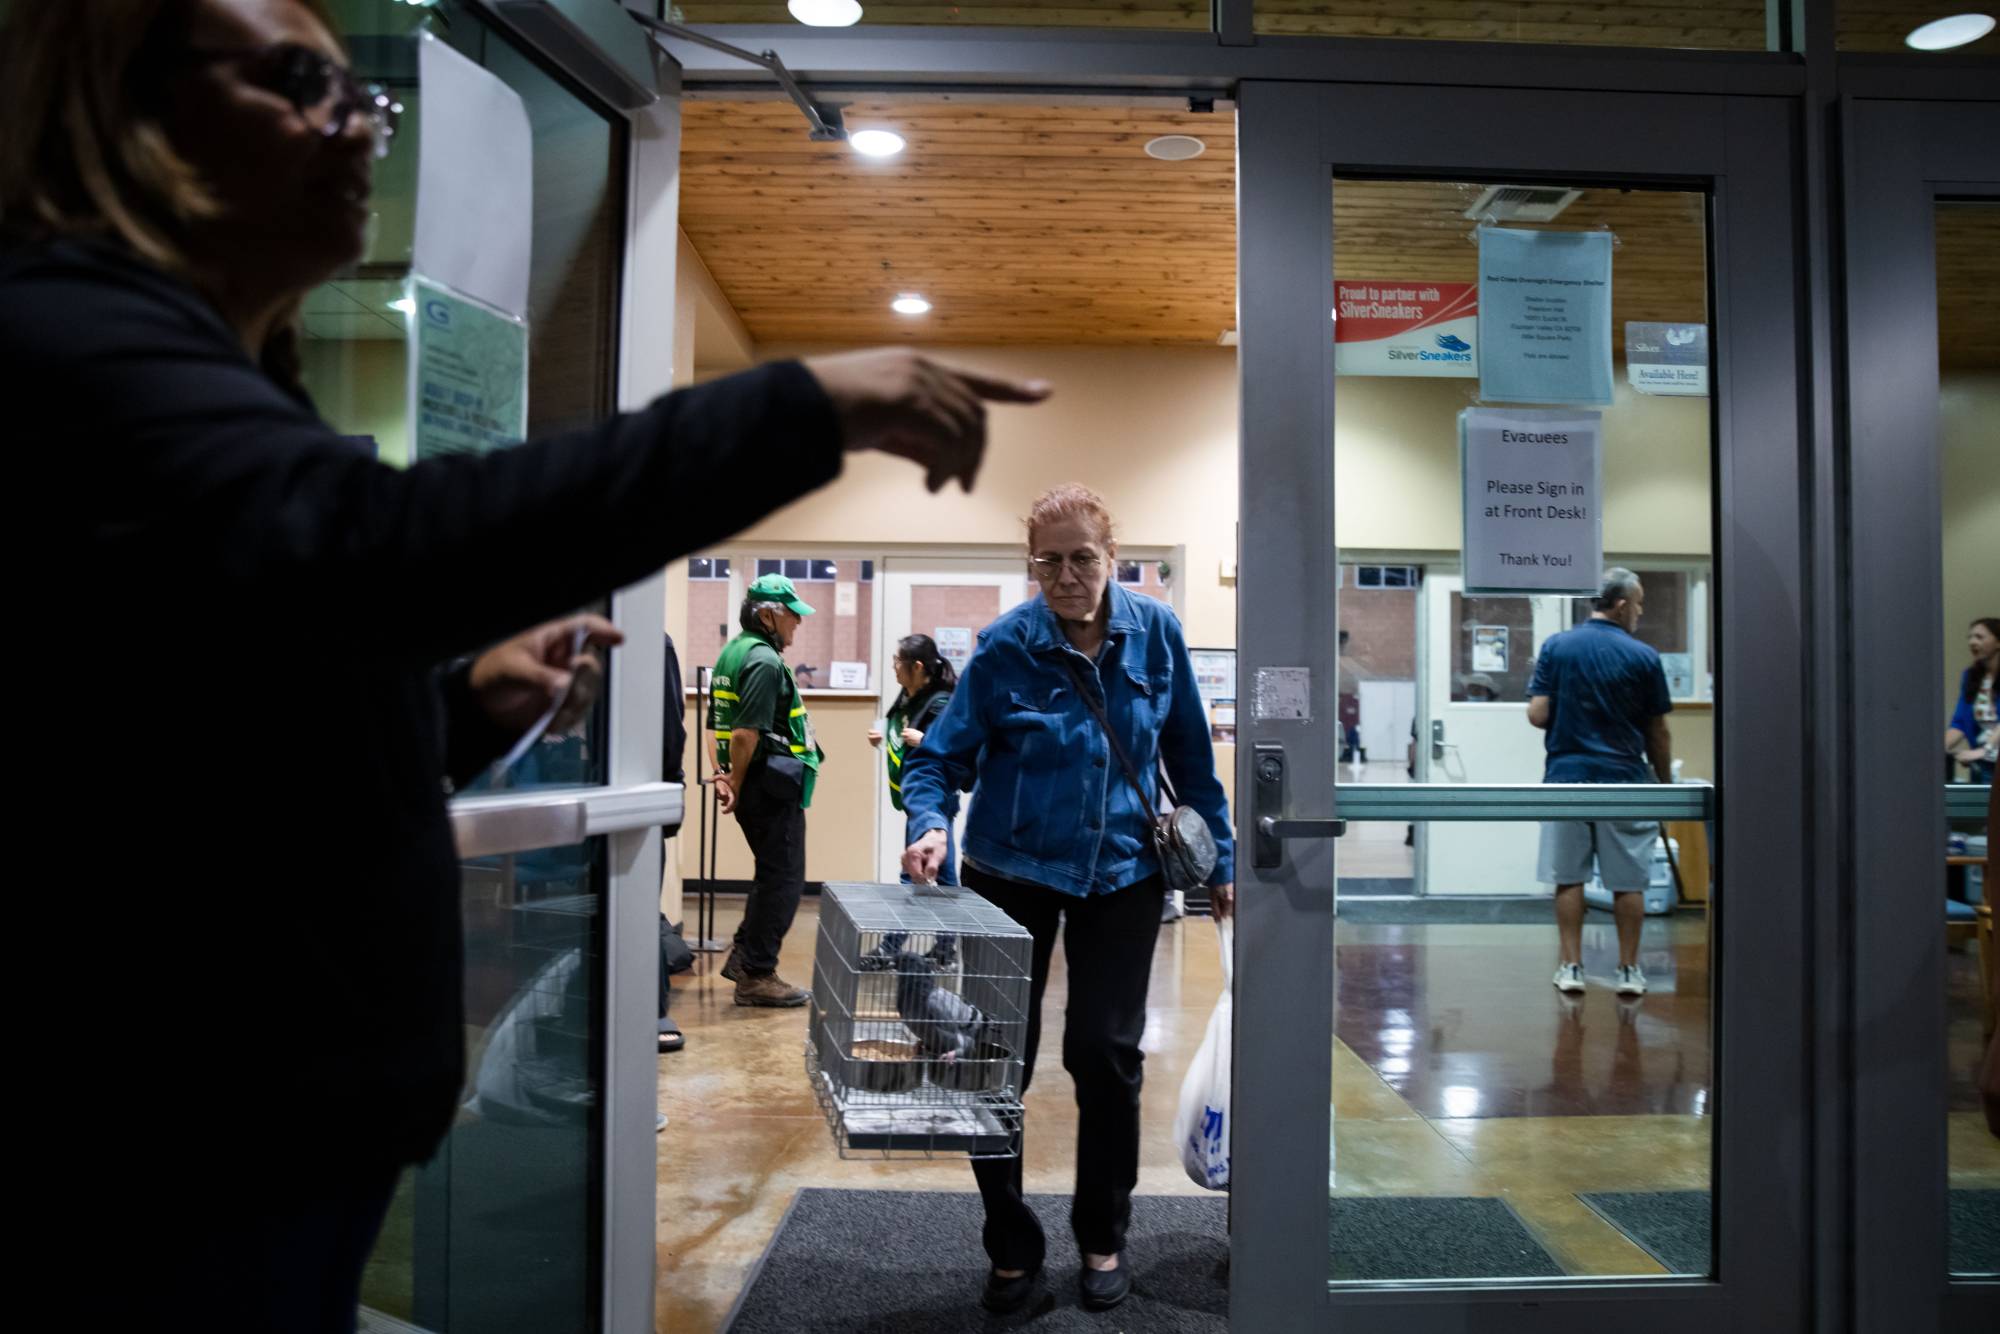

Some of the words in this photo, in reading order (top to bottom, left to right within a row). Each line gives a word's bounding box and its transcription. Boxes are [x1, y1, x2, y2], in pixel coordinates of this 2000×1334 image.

[1339, 286, 1367, 300] Proud
[1369, 287, 1380, 300] to
[1382, 288, 1416, 303] partner
[1418, 288, 1440, 302] with
[1339, 301, 1424, 319] SilverSneakers
[1388, 350, 1472, 361] SilverSneakers
[1639, 369, 1675, 379] Available
[1502, 430, 1568, 444] Evacuees
[1487, 480, 1533, 494] Please
[1537, 481, 1567, 498] Sign
[1571, 482, 1585, 496] in
[1484, 505, 1499, 517] at
[1503, 504, 1543, 519] Front
[1547, 505, 1587, 520] Desk!
[1498, 553, 1540, 566] Thank
[1542, 554, 1573, 567] You!
